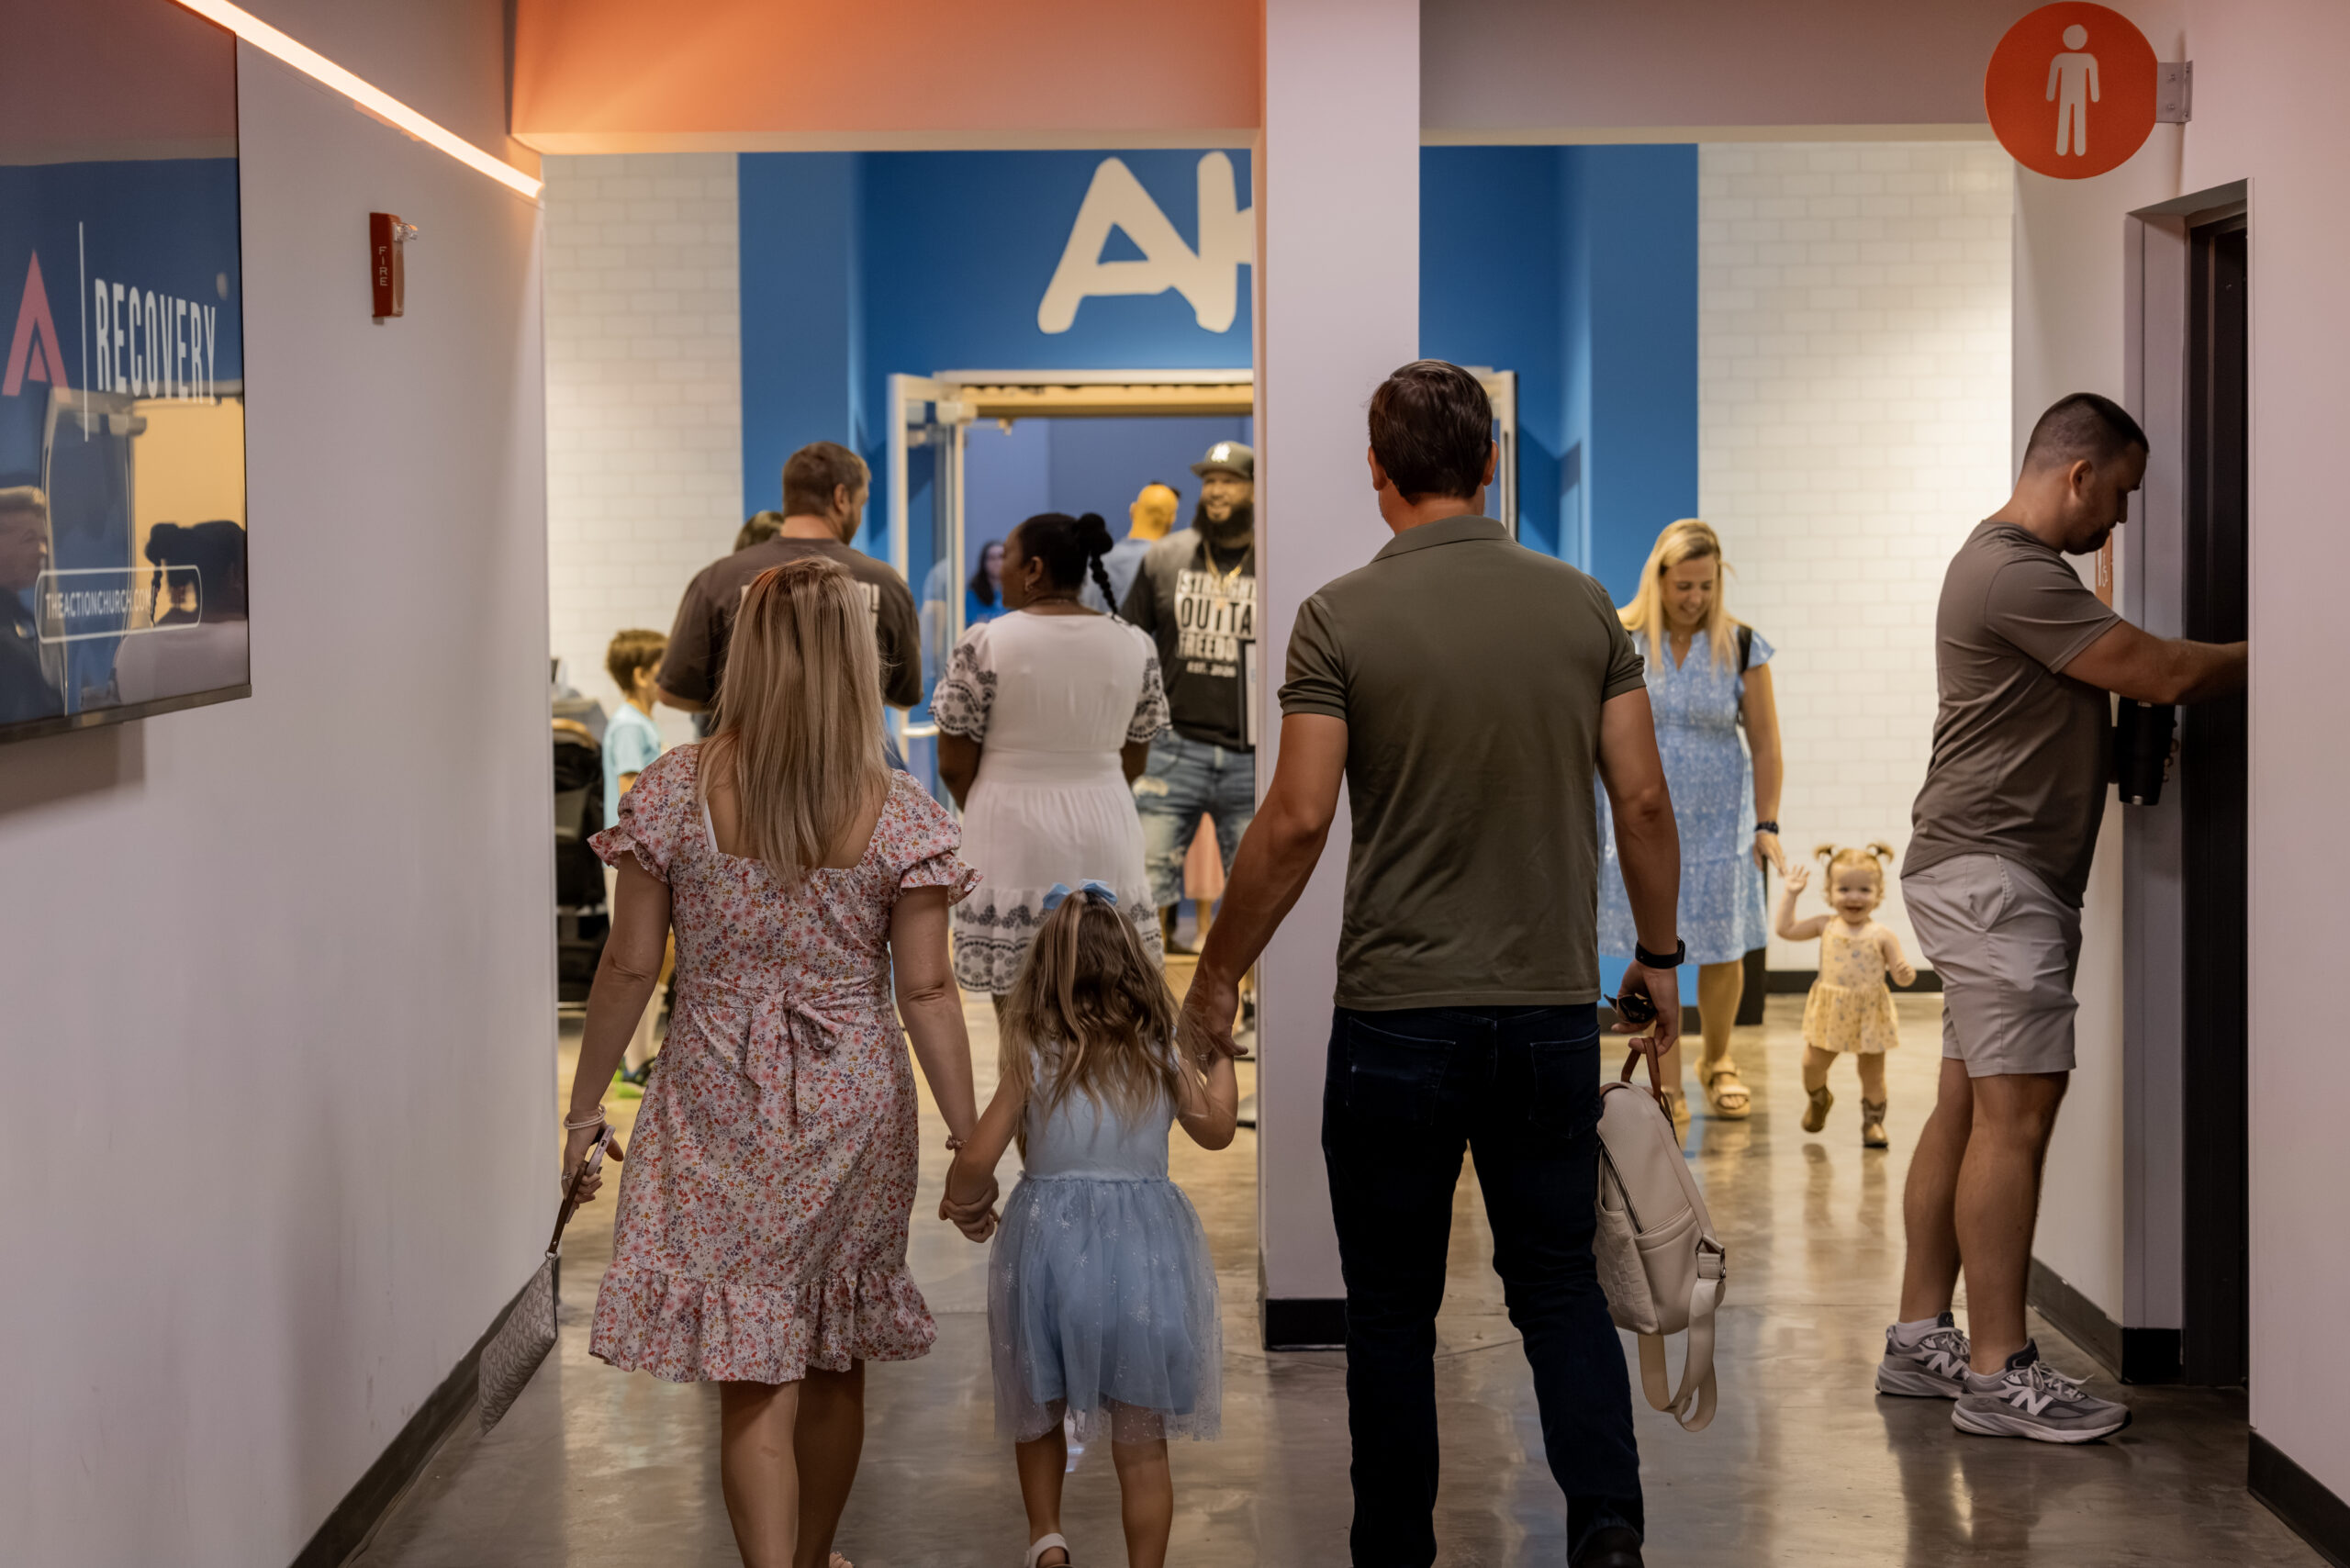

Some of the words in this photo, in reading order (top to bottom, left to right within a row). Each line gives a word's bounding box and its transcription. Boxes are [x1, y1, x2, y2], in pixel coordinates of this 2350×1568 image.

[378, 245, 389, 287] FIRE
[95, 277, 216, 406] RECOVERY
[1181, 598, 1252, 636] OUTTA
